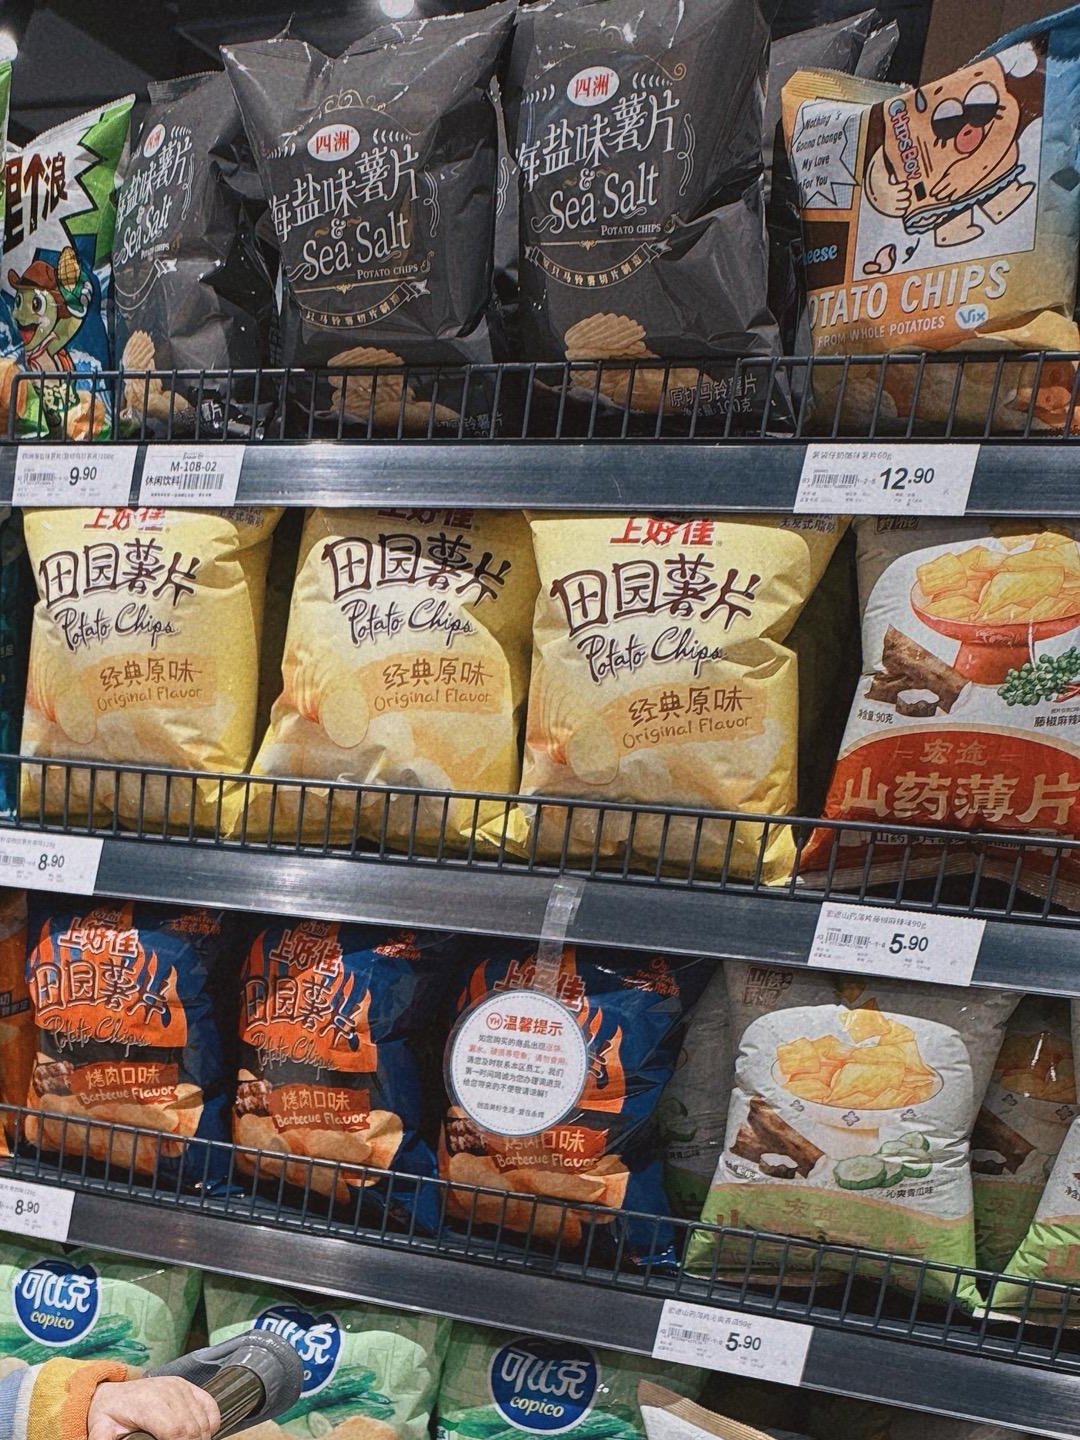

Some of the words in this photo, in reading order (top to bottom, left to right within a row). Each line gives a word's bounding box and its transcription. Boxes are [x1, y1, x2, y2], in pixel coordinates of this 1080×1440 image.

[575, 73, 609, 98] 四洲
[316, 130, 350, 154] 四洲
[516, 90, 680, 192] 海盐味薯片
[818, 130, 844, 148] Change
[802, 158, 814, 172] My
[815, 154, 830, 168] Love
[269, 144, 419, 242] 海盐味薯片
[579, 168, 595, 191] &
[550, 191, 597, 234] Sea
[603, 162, 659, 218] Salt
[121, 226, 142, 264] Sea
[144, 194, 172, 244] Salt
[330, 218, 347, 239] &
[303, 239, 352, 281] Sea
[356, 210, 410, 264] Salt
[900, 259, 1010, 313] CHIPS
[849, 326, 884, 341] WHOLE
[889, 316, 945, 336] POTATOES
[70, 466, 97, 486] 9.90
[879, 468, 935, 490] 12.90
[610, 517, 714, 546] 上好佳
[39, 538, 200, 609] 田园薯片
[321, 532, 511, 607] 田园薯片
[550, 553, 761, 638] 田园薯片
[54, 607, 110, 651] Potato
[115, 602, 176, 647] Chips
[341, 599, 403, 644] Potato
[408, 597, 474, 646] Chips
[577, 634, 645, 682] Potato
[652, 627, 722, 677] Chips
[100, 658, 203, 691] 经典原味
[383, 657, 493, 690] 经典原味
[97, 687, 152, 712] Original
[157, 686, 203, 702] Flavor
[375, 689, 439, 711] Original
[445, 688, 491, 703] Flavor
[629, 685, 752, 726] 经典原味
[623, 722, 692, 748] Original
[699, 716, 752, 732] Flavor
[919, 738, 988, 766] 宏途
[839, 766, 1080, 825] 山药薄片
[38, 853, 65, 871] 8.90
[58, 917, 139, 957] 上好佳
[889, 933, 929, 954] 5.90
[270, 929, 344, 977] 上好佳
[34, 958, 170, 1024] 田园薯片
[245, 975, 362, 1047] 田园薯片
[503, 1014, 563, 1037] 温馨提示
[44, 1017, 92, 1053] Potato
[251, 1033, 289, 1071] Potato
[86, 1066, 160, 1089] 烤肉口味
[80, 1090, 129, 1105] Barbecue
[132, 1085, 180, 1099] Flavor
[282, 1090, 350, 1111] 烤肉口味
[275, 1112, 322, 1125] Barbecue
[324, 1112, 369, 1124] Flavor
[497, 1154, 548, 1168] Barbecue
[552, 1153, 598, 1168] Flavor
[15, 1199, 39, 1215] 8.90
[22, 1269, 94, 1313] 可比克
[31, 1312, 74, 1330] copico
[726, 1332, 761, 1351] 5.90
[501, 1352, 591, 1396] 可比克
[510, 1395, 565, 1417] copico
